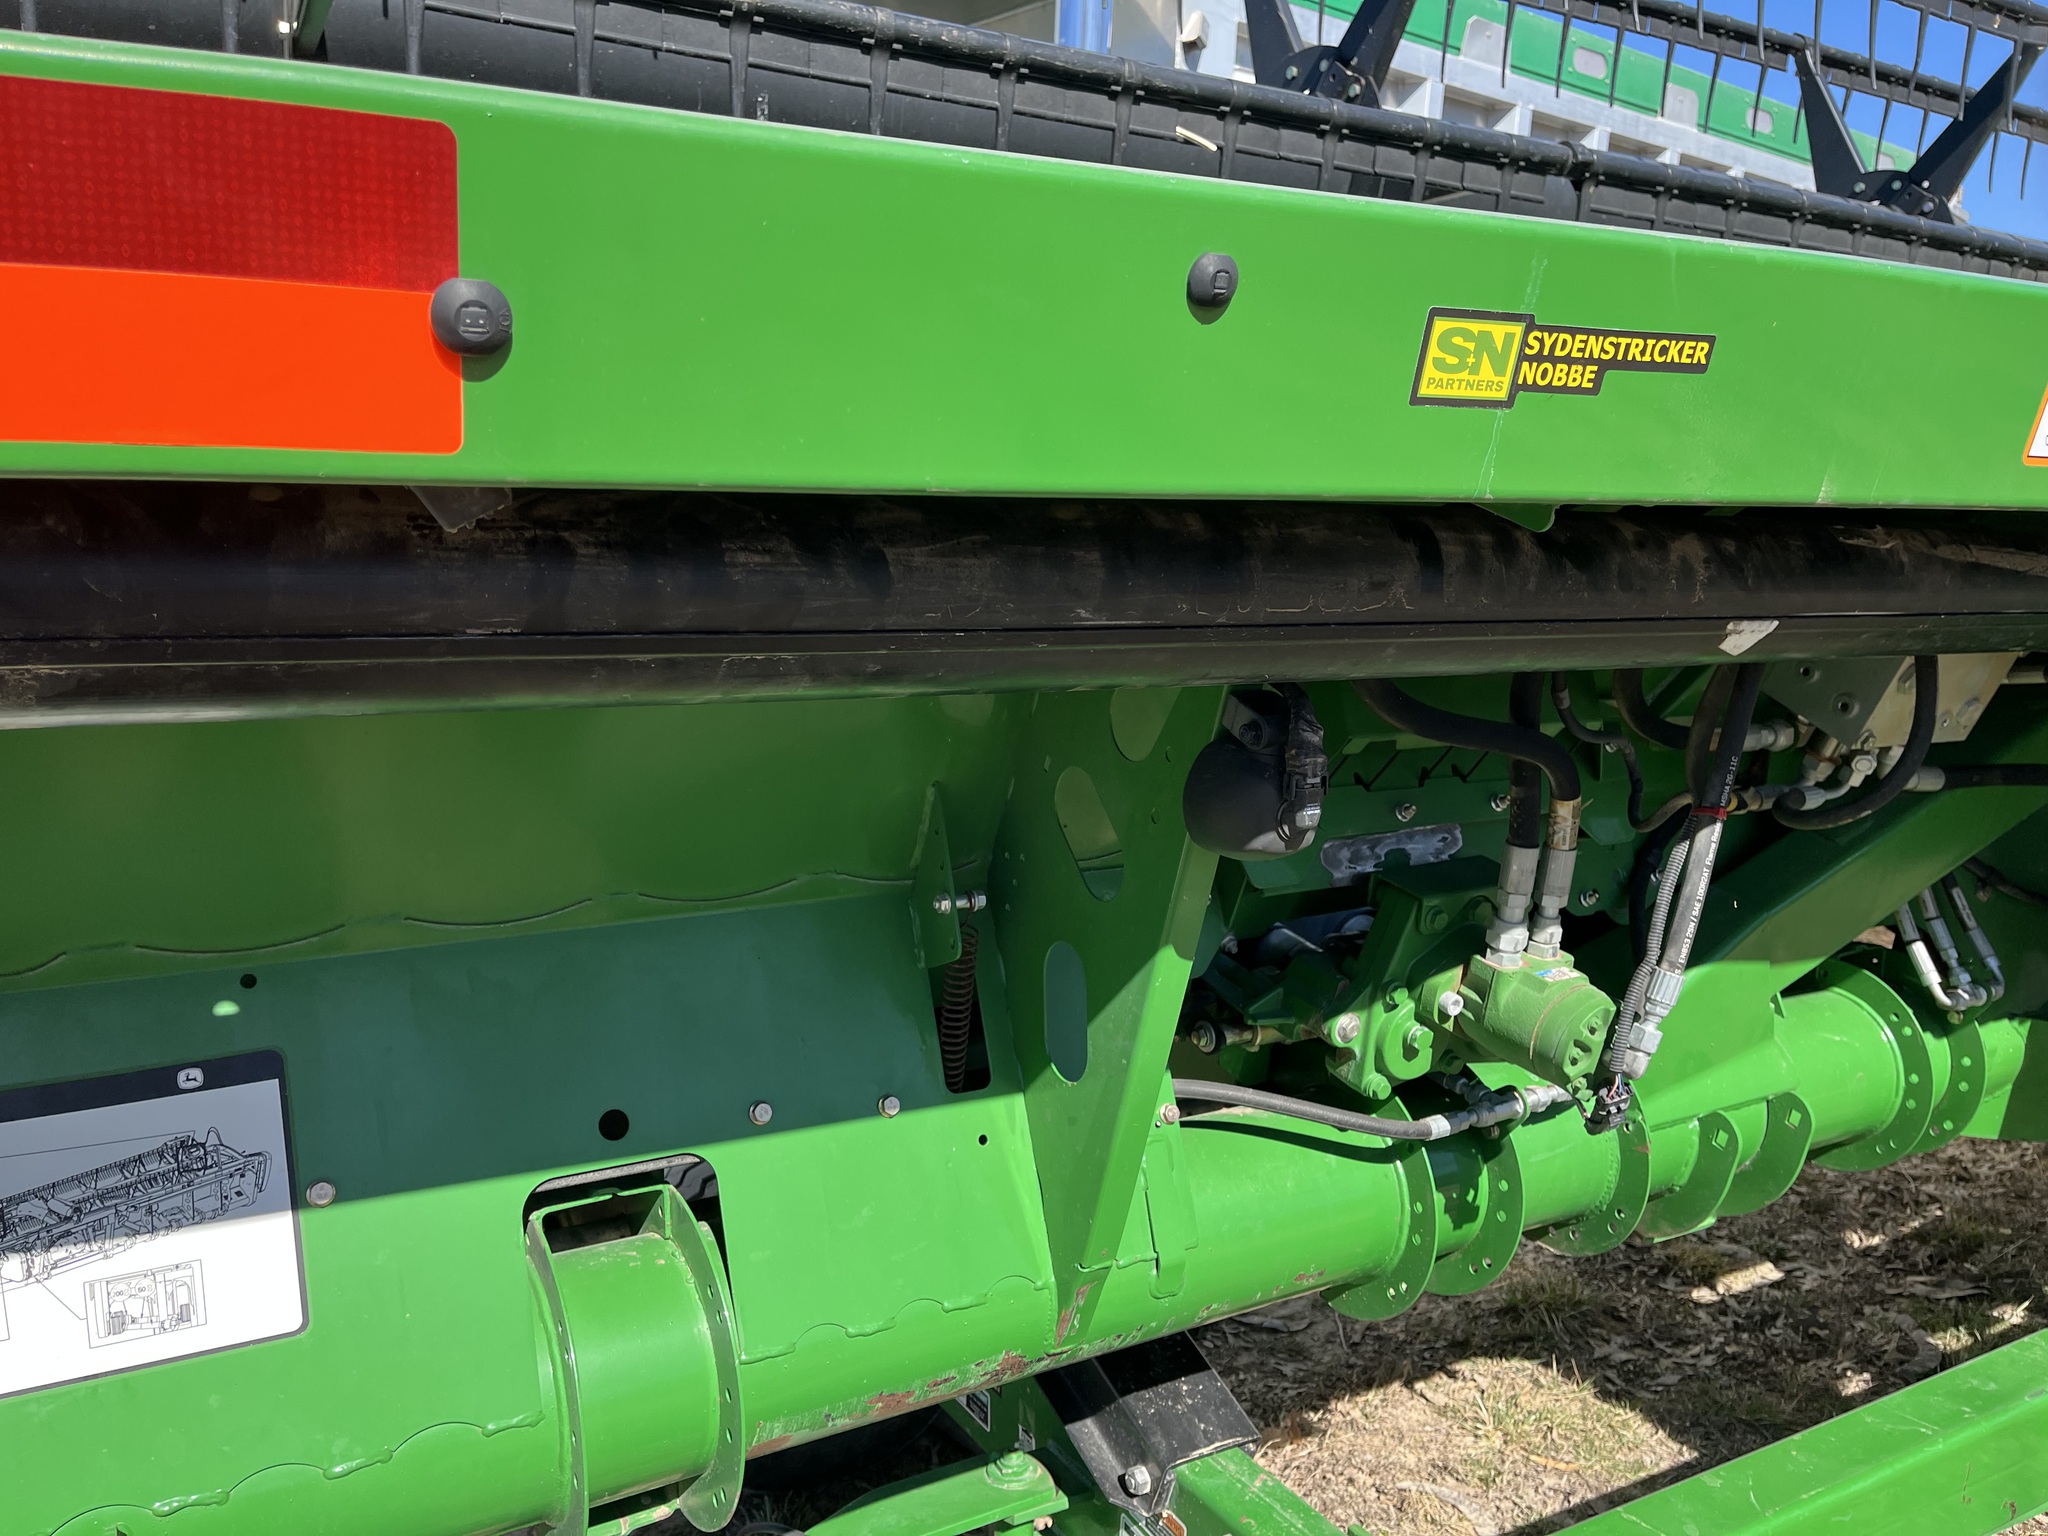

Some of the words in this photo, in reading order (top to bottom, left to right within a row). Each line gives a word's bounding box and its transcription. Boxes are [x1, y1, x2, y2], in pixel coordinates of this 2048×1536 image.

[1524, 331, 1710, 365] SYDENSTRICKER
[1426, 377, 1504, 392] PARTNERS
[1517, 361, 1598, 388] NOBBE
[1720, 785, 1731, 806] MSHA
[1705, 842, 1716, 866] Flame
[1696, 867, 1710, 900] 100R2AT
[1692, 901, 1702, 917] SAE
[1686, 921, 1696, 938] 2SN
[1679, 938, 1691, 963] EN853
